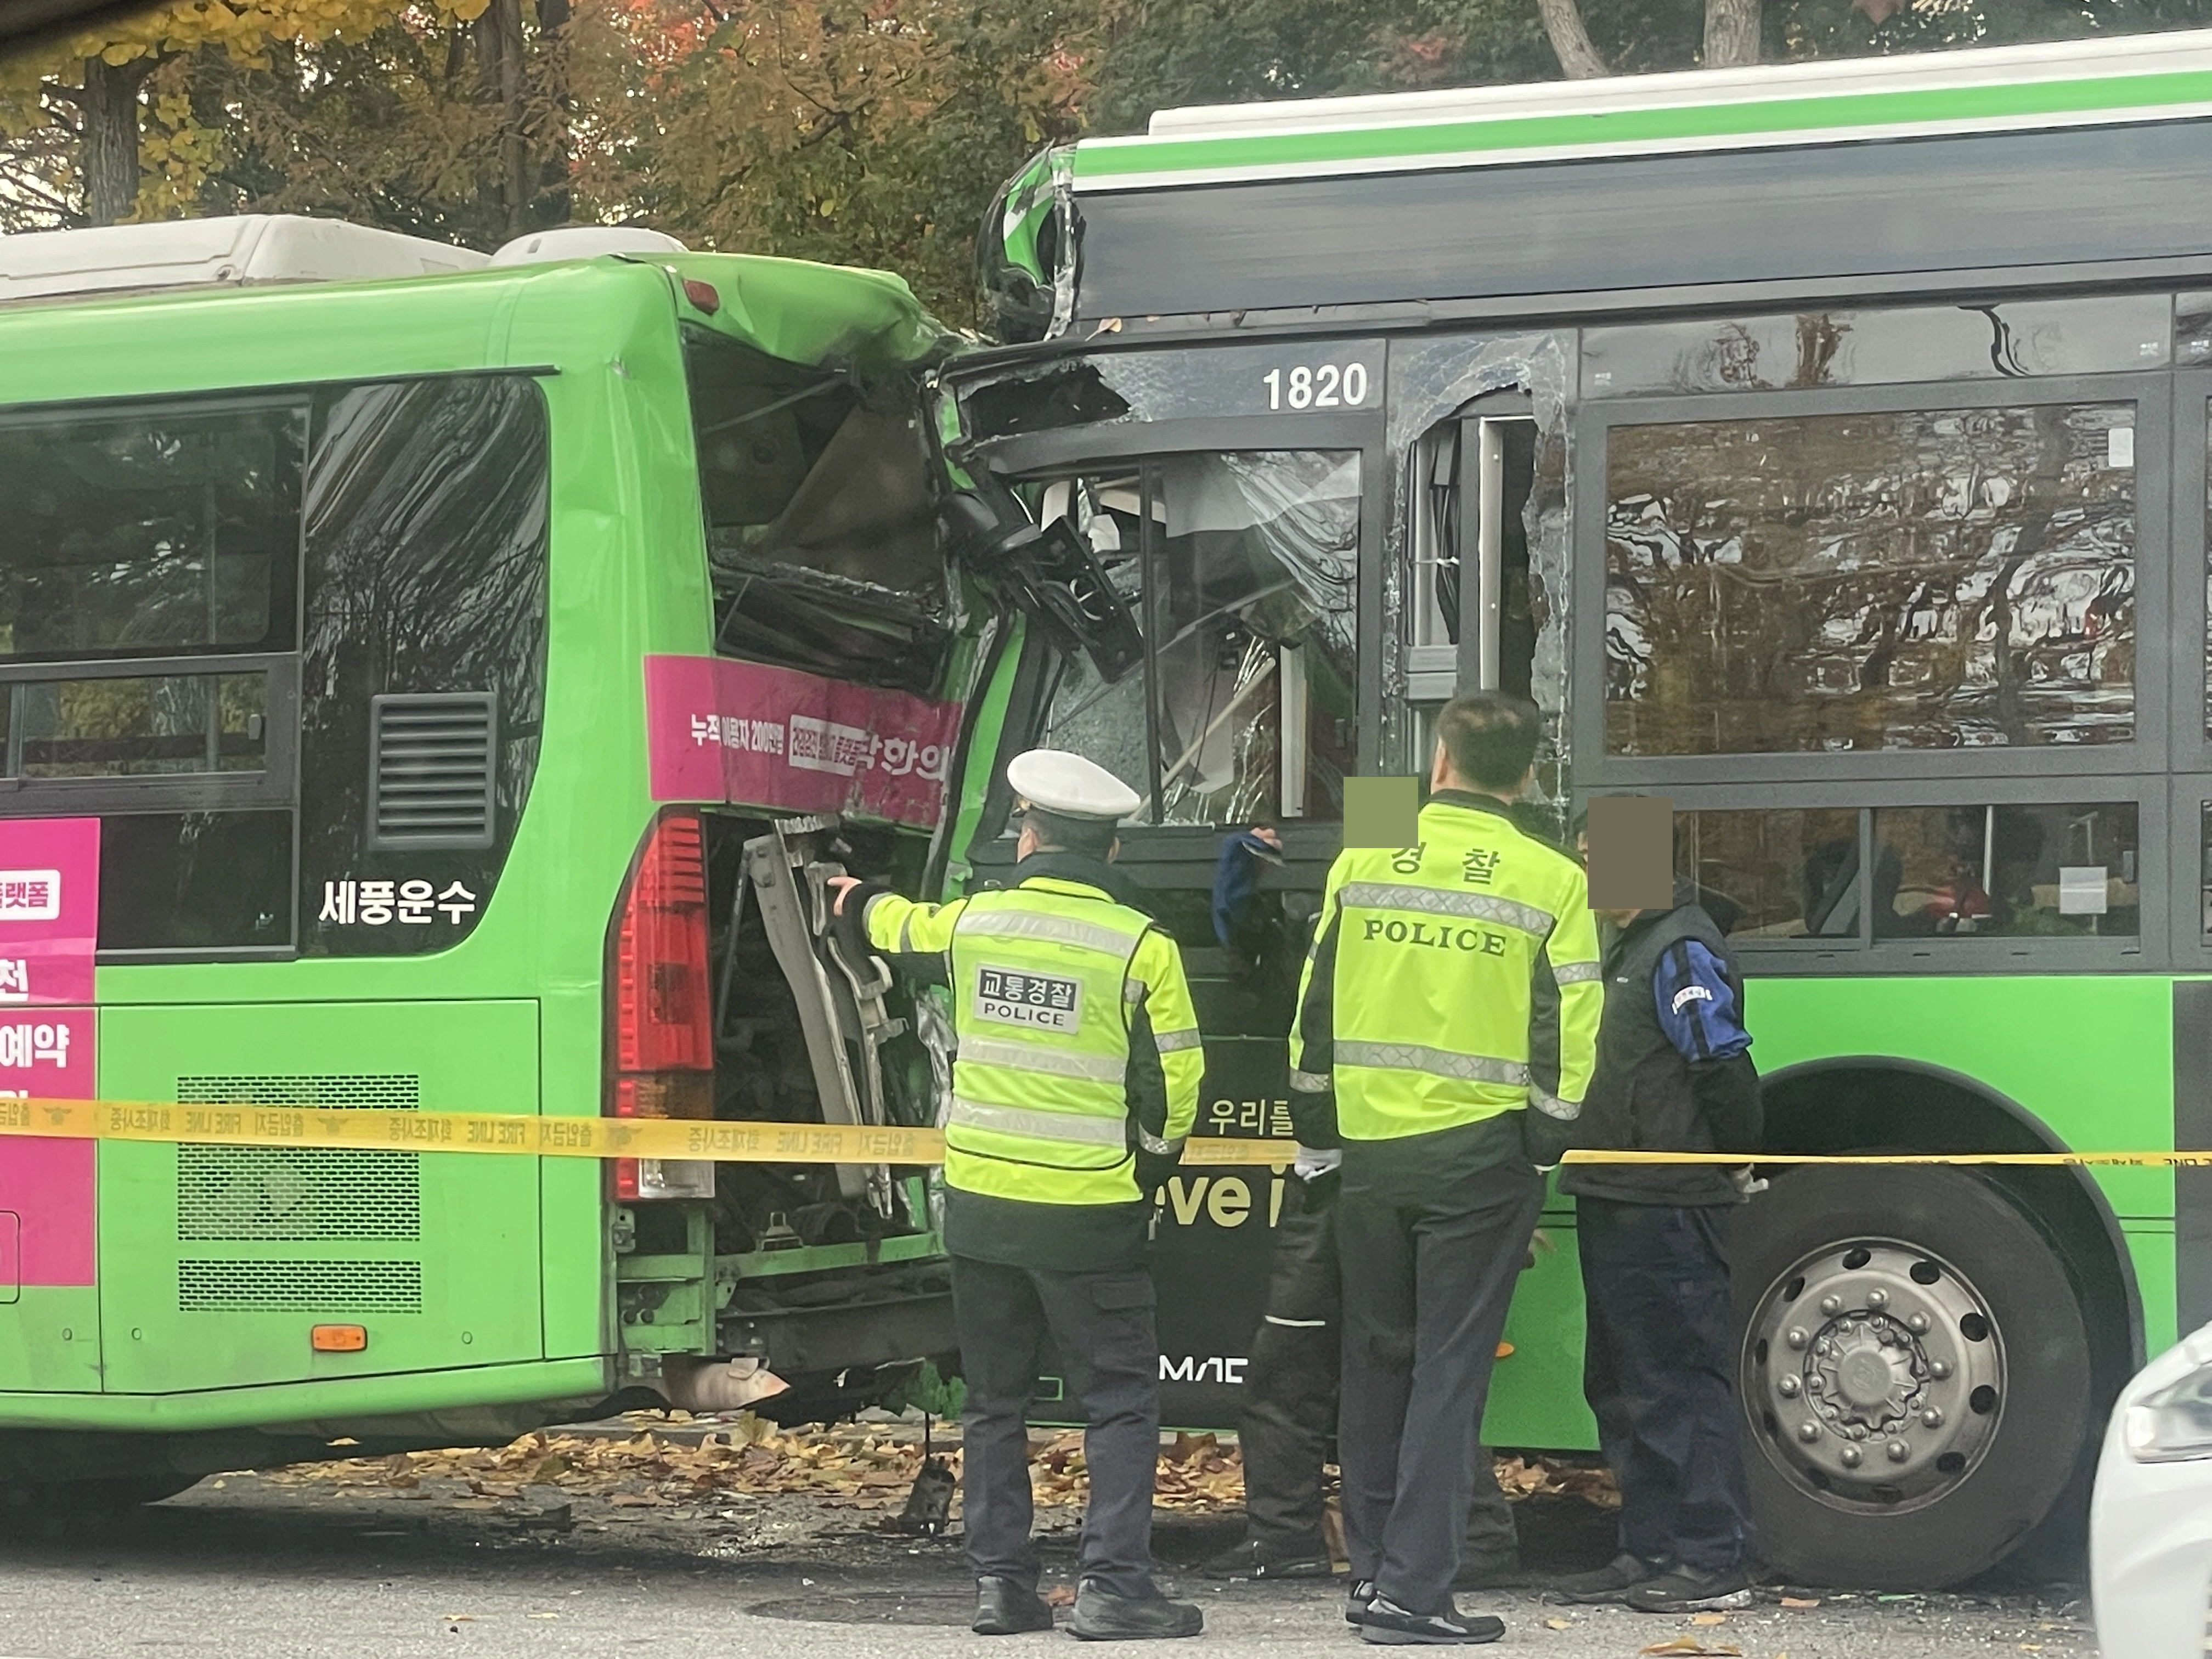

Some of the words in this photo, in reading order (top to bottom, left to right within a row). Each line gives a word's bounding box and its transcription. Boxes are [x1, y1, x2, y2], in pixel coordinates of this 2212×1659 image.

[1263, 363, 1367, 410] 1820
[0, 881, 48, 909] 랫폼
[319, 880, 476, 924] 세풍운수
[1363, 919, 1507, 958] POLICE
[983, 972, 1073, 1009] 교통경찰
[984, 1002, 1065, 1026] POLICE
[0, 1024, 70, 1068] 예약
[1155, 1176, 1251, 1228] ve
